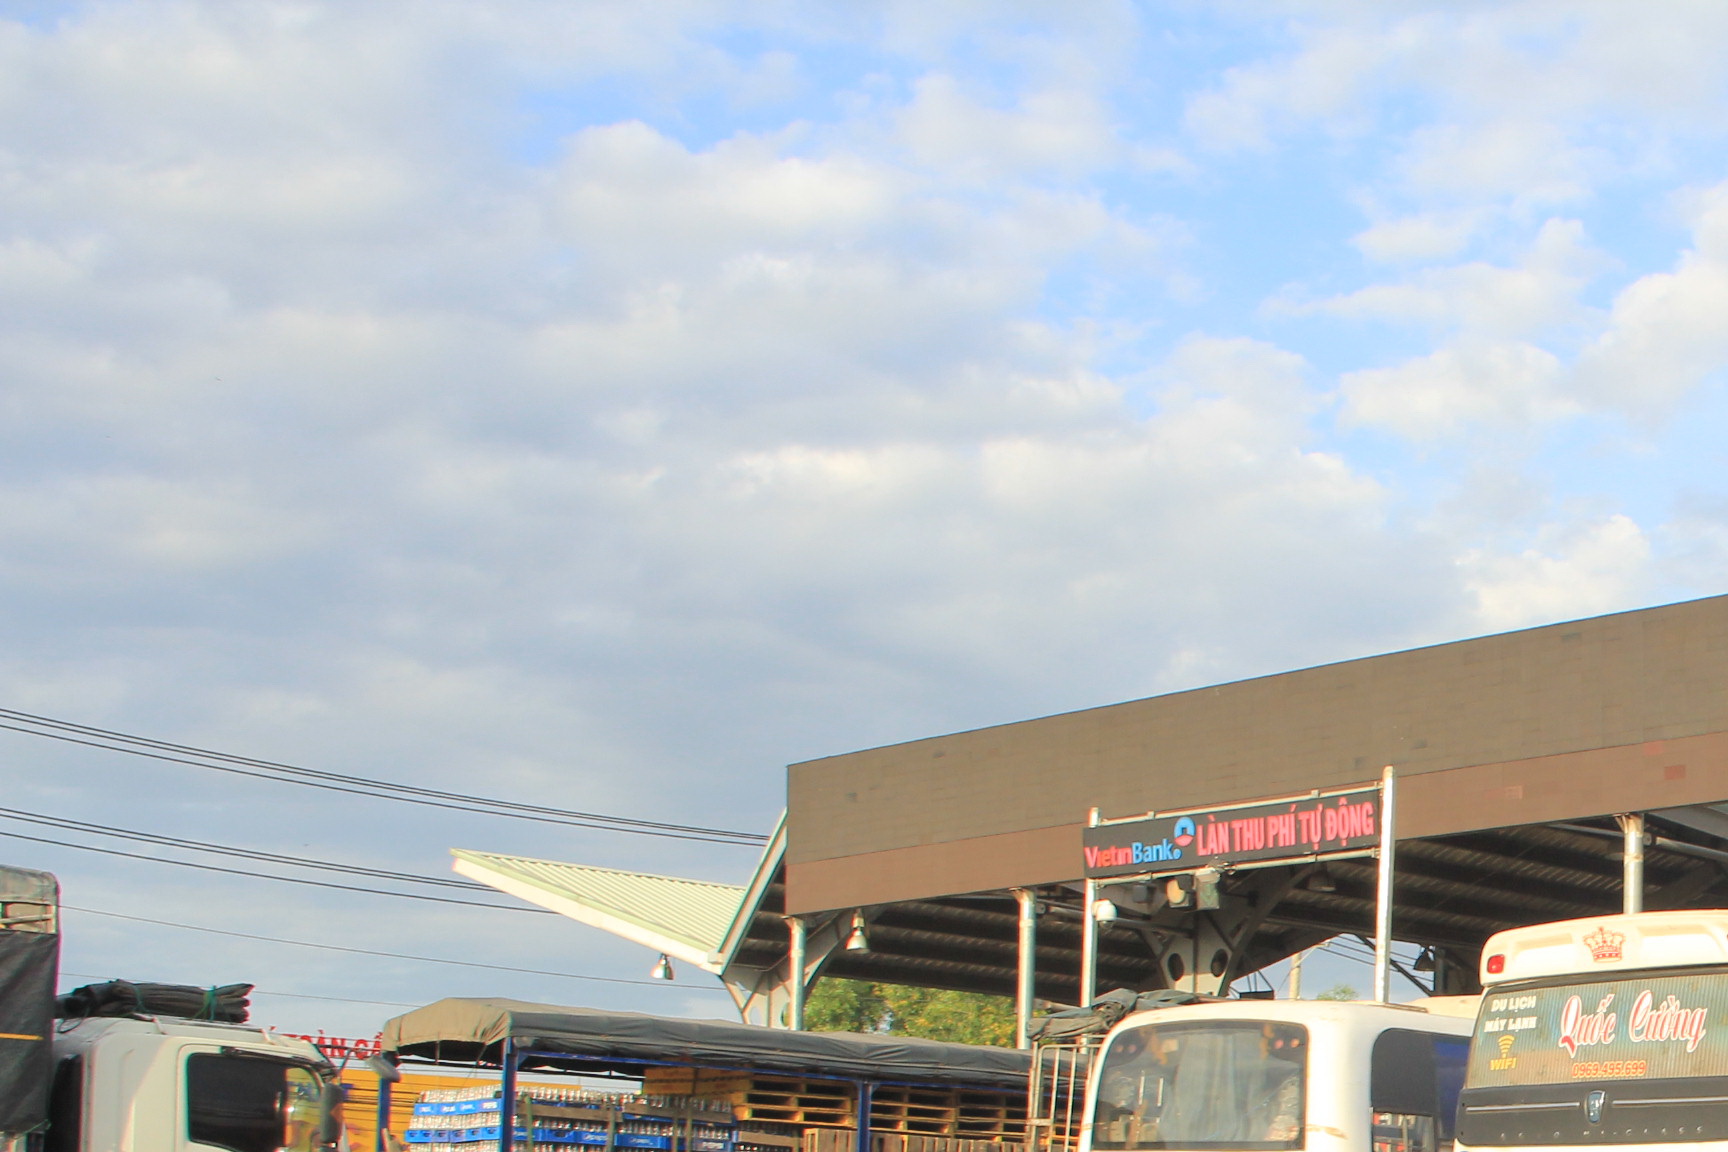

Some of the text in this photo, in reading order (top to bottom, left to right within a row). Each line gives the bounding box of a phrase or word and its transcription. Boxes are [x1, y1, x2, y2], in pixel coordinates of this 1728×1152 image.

[1196, 797, 1375, 856] LÀN THU PHÍ TỰ ĐỘNG
[1084, 838, 1174, 869] VietinBank
[1491, 995, 1537, 1012] DU LỊCH
[1490, 1057, 1517, 1071] WIFI
